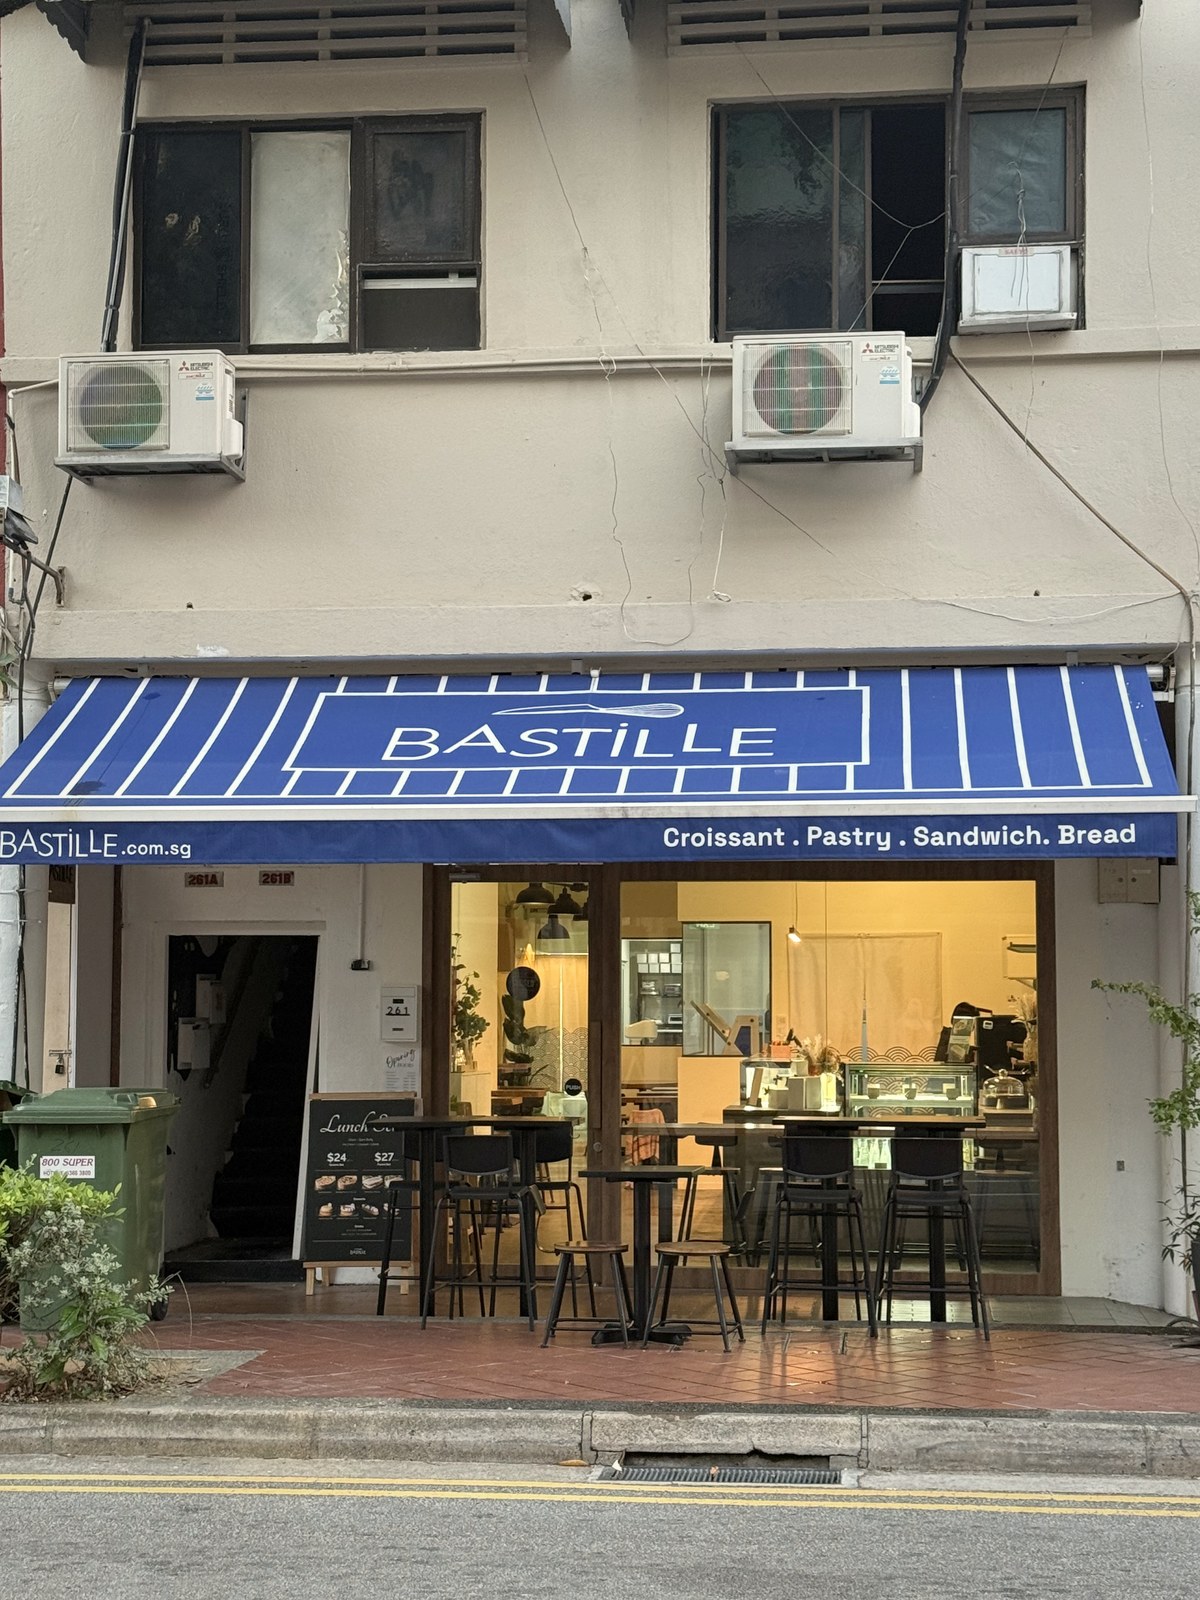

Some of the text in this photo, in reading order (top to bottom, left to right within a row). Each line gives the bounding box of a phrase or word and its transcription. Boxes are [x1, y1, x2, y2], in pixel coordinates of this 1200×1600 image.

[663, 827, 786, 848] Croissant
[807, 825, 891, 851] Pastry
[1057, 823, 1136, 845] Bread
[188, 874, 219, 886] 261A
[262, 872, 292, 884] 261B
[386, 1006, 409, 1016] 261
[320, 1110, 376, 1133] Lunch
[41, 1158, 93, 1167] 800 SUPER
[327, 1152, 347, 1163] $24
[374, 1151, 395, 1163] $27
